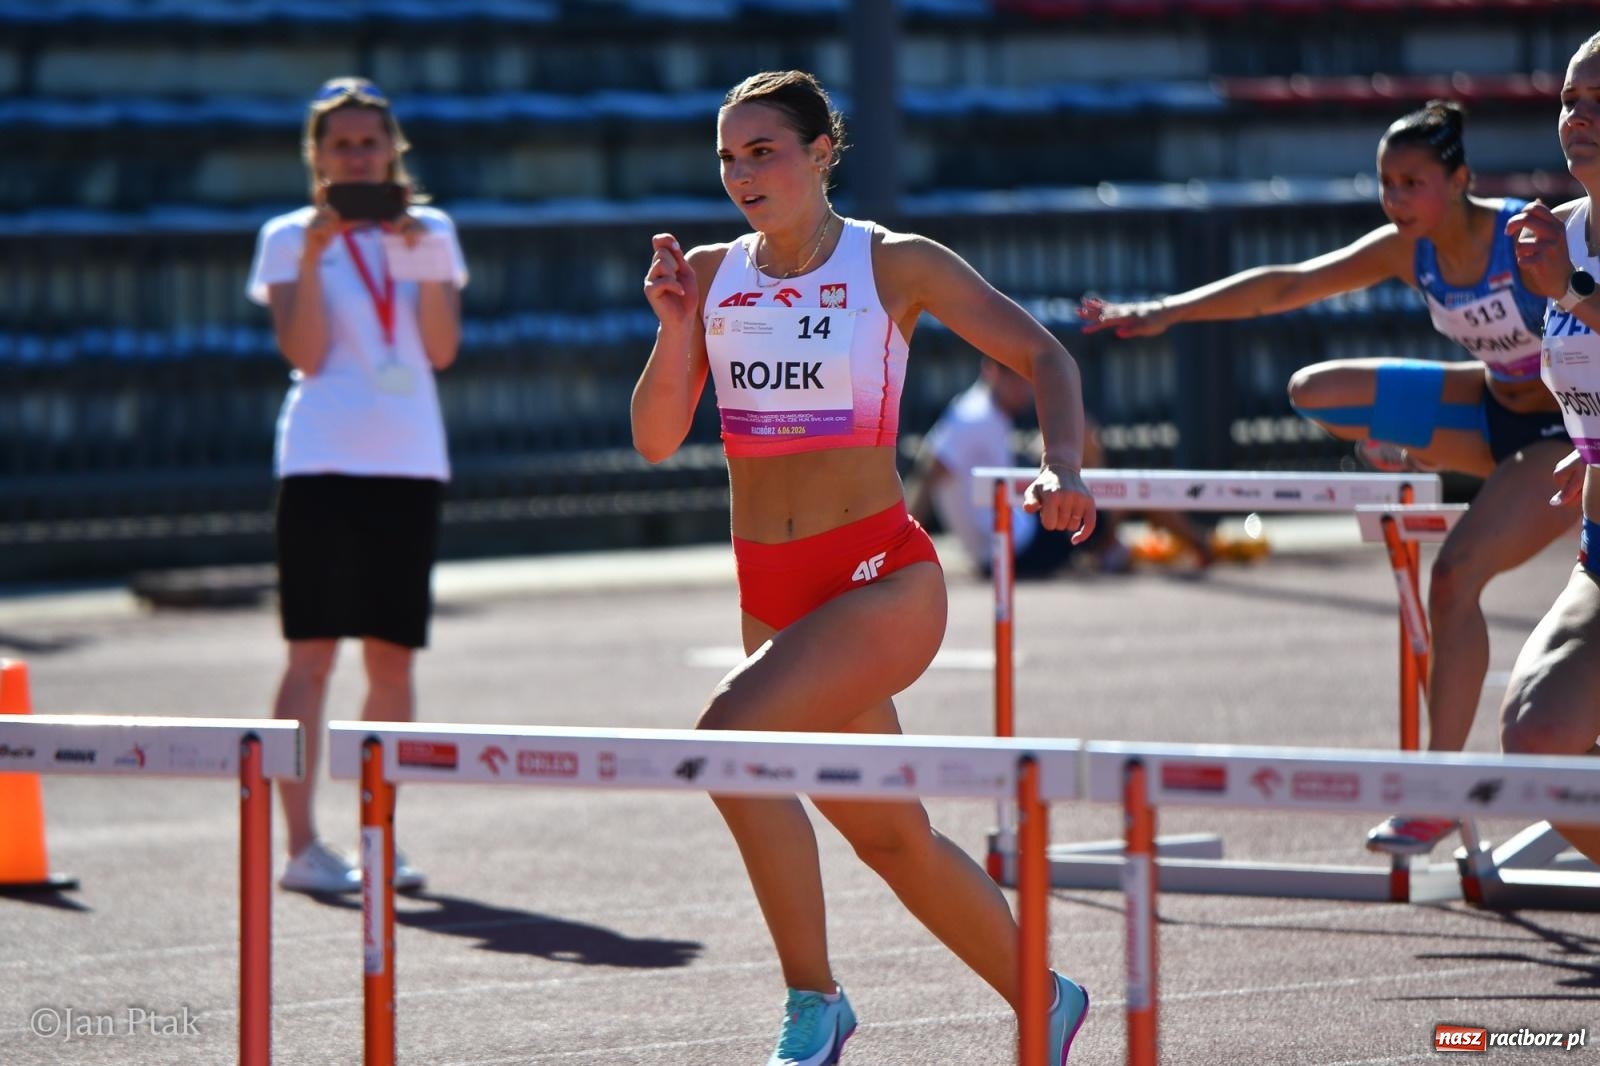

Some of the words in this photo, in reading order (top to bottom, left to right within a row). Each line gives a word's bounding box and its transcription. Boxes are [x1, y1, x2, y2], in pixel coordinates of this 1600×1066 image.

[1463, 300, 1507, 327] 513
[797, 316, 831, 340] 14
[730, 361, 824, 390] ROJEK
[851, 551, 887, 582] 4F
